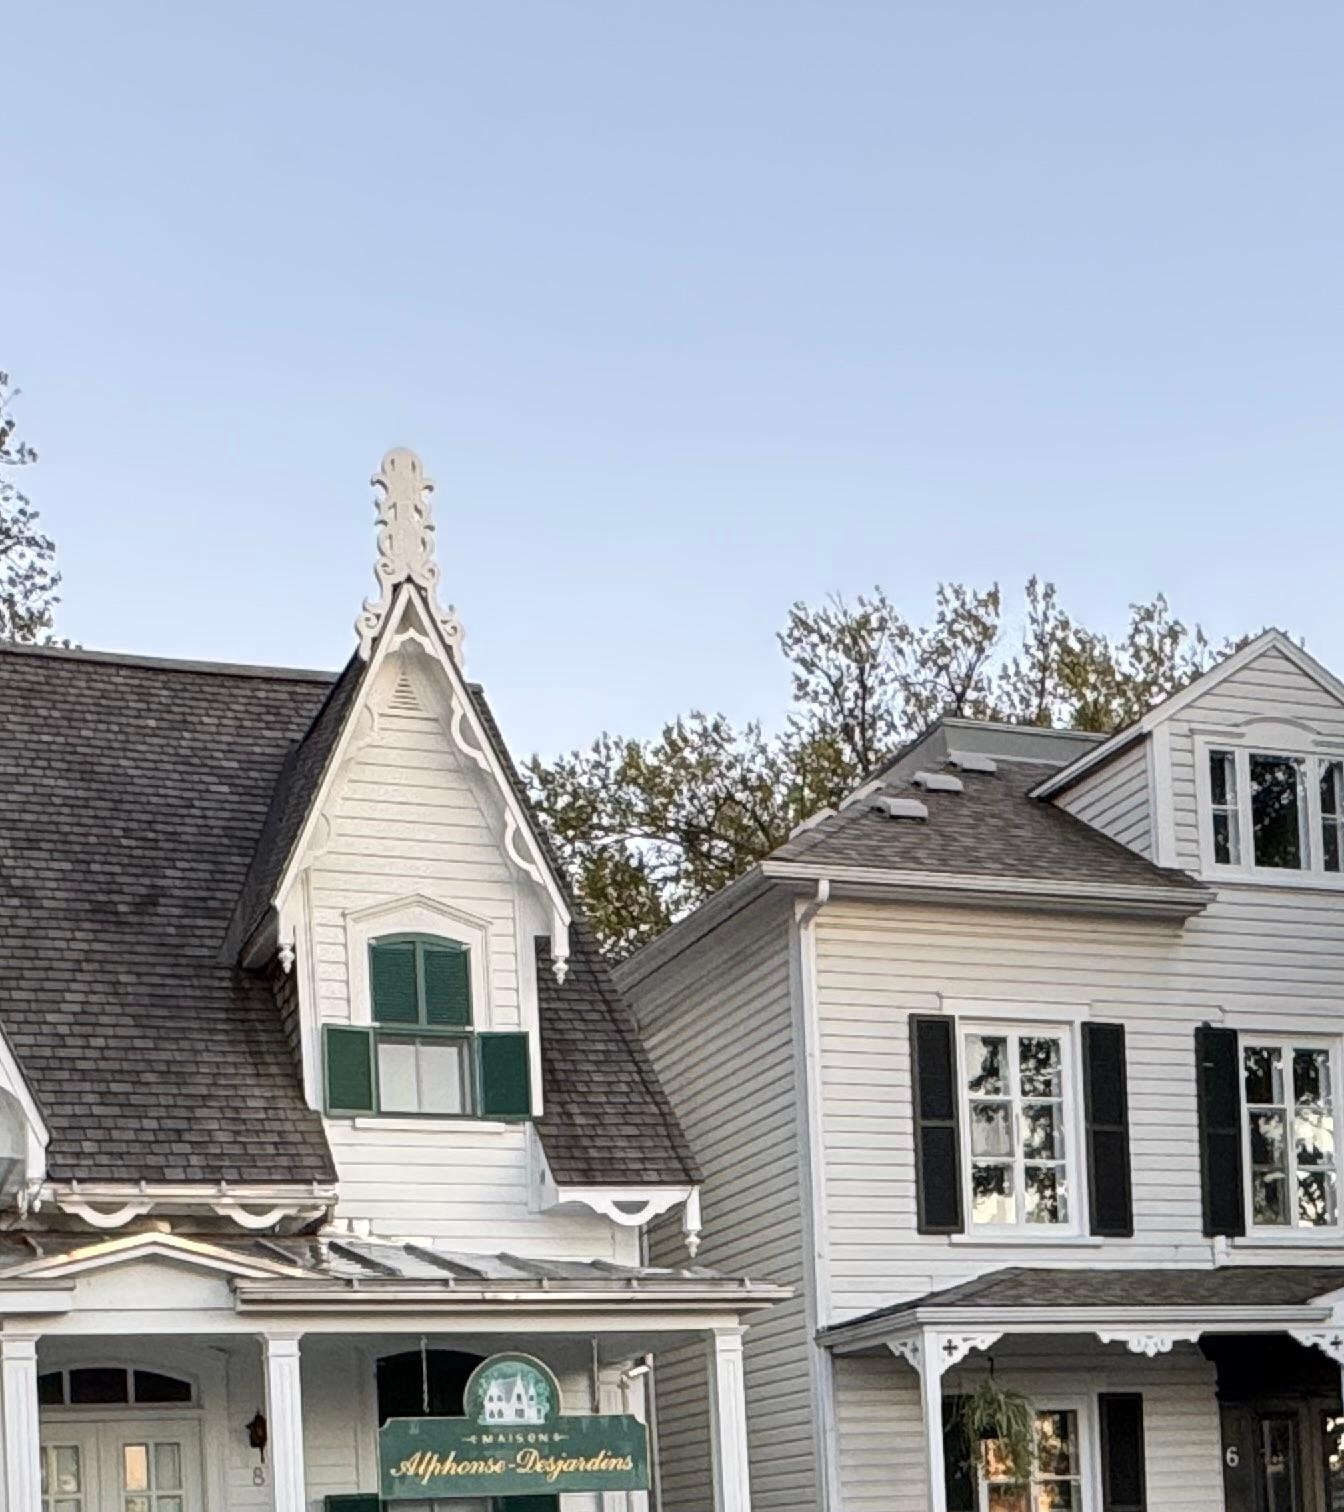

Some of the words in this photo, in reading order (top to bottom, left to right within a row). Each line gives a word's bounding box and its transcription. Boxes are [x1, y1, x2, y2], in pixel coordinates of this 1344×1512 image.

[482, 1432, 549, 1444] MAISON
[1226, 1446, 1239, 1467] 6
[252, 1466, 265, 1487] 8
